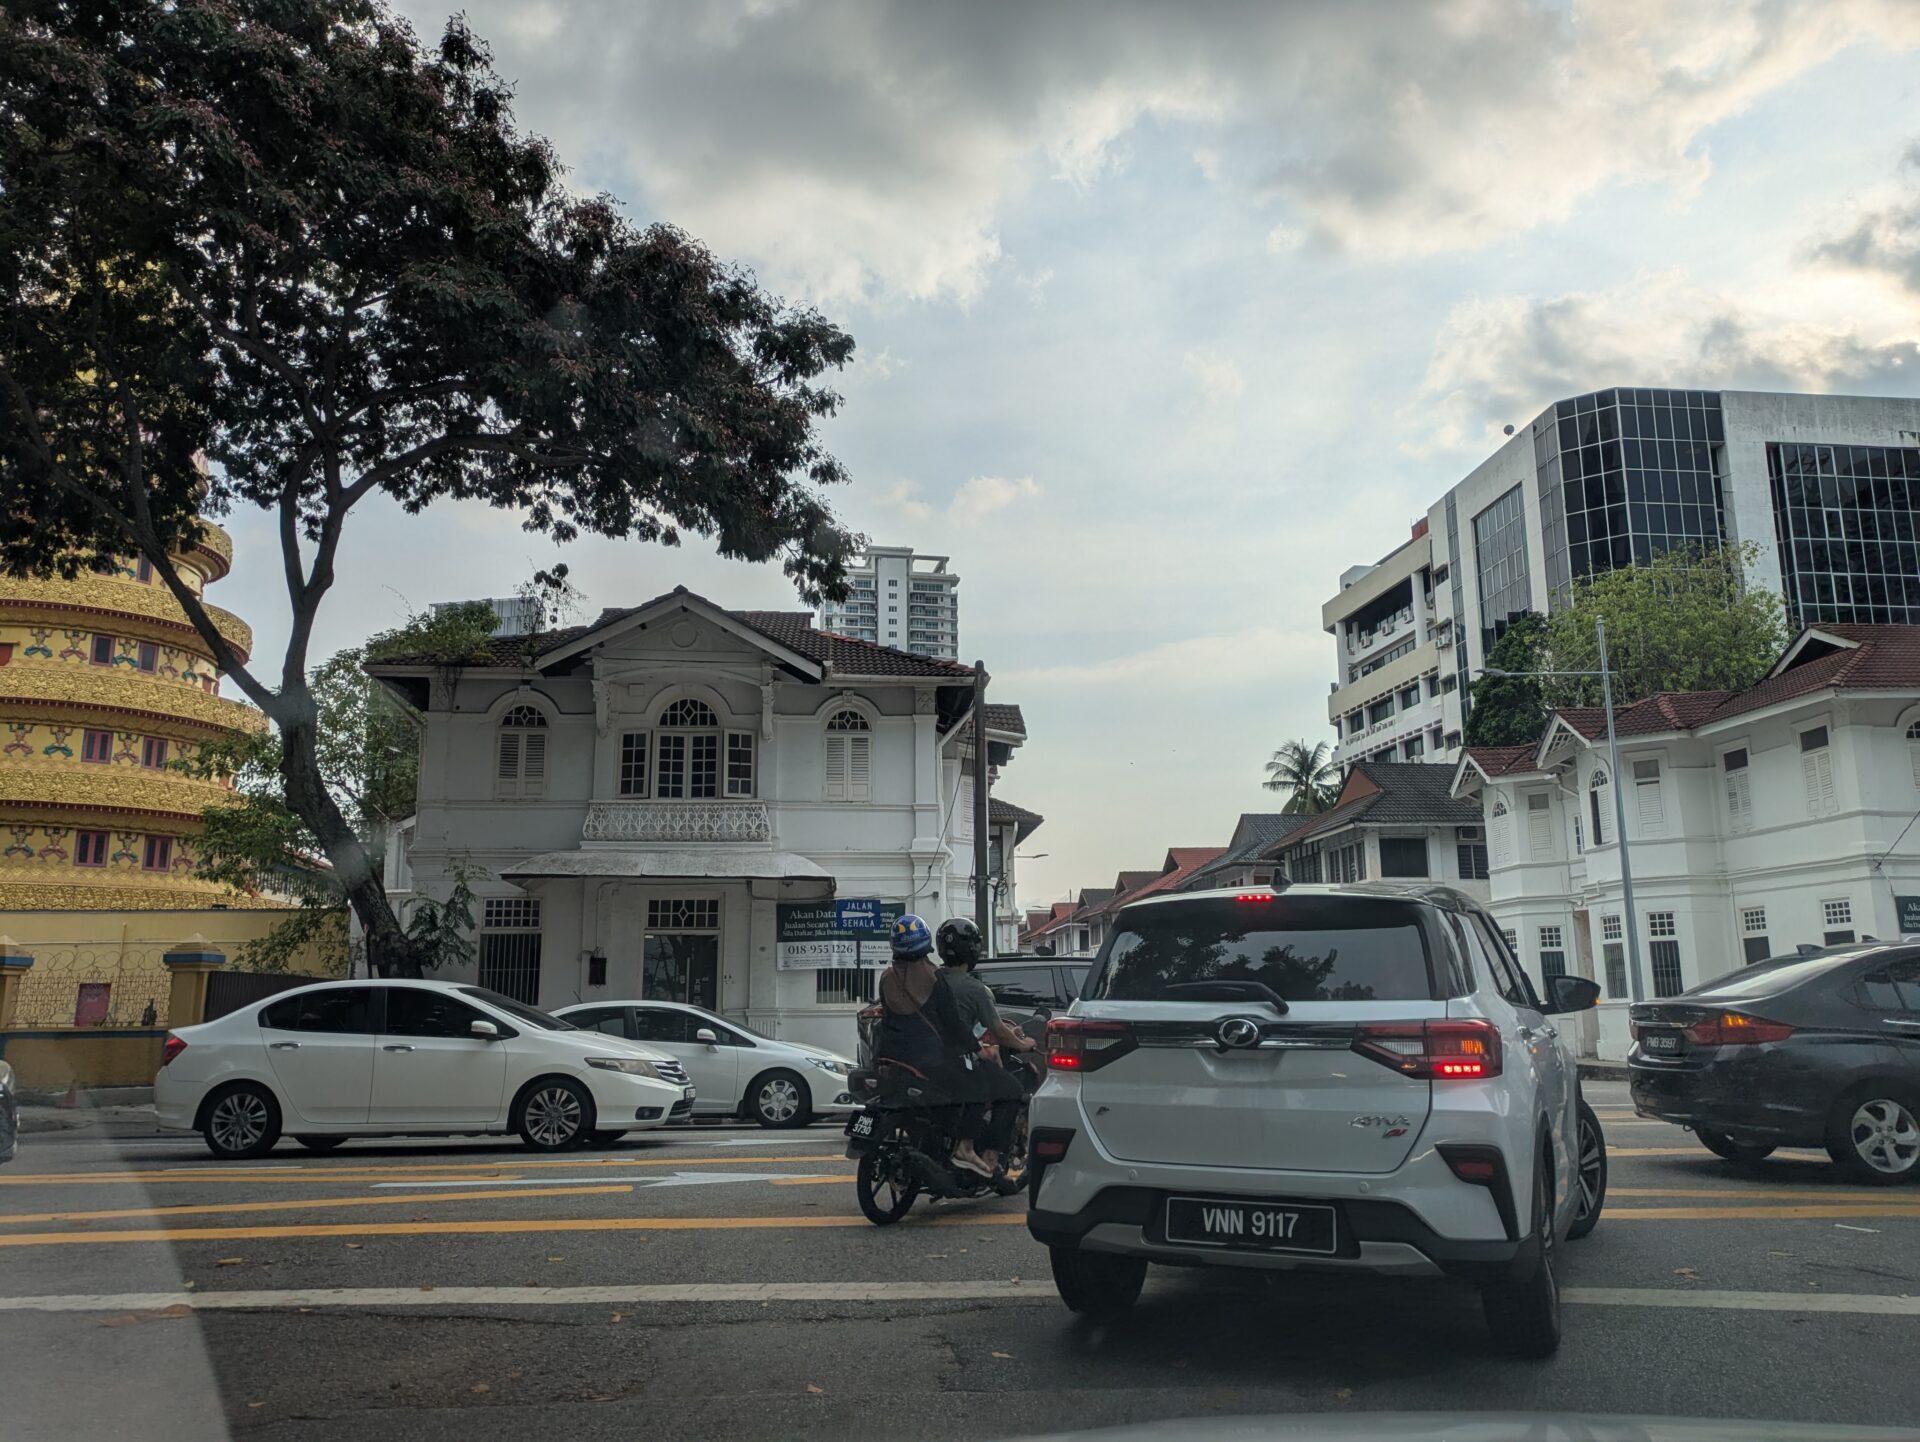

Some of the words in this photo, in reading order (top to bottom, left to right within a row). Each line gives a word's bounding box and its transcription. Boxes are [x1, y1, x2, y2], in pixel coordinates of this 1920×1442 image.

[846, 901, 873, 910] JALAN
[790, 910, 814, 919] Akan
[785, 921, 806, 930] Jualan
[806, 920, 829, 929] Secara
[842, 919, 875, 928] SEHALA
[787, 945, 829, 955] 018-955
[831, 944, 853, 954] 1226
[857, 1115, 874, 1126] PNH
[852, 1123, 872, 1135] 3730
[1202, 1207, 1244, 1235] VNN
[1251, 1211, 1299, 1239] 9117
